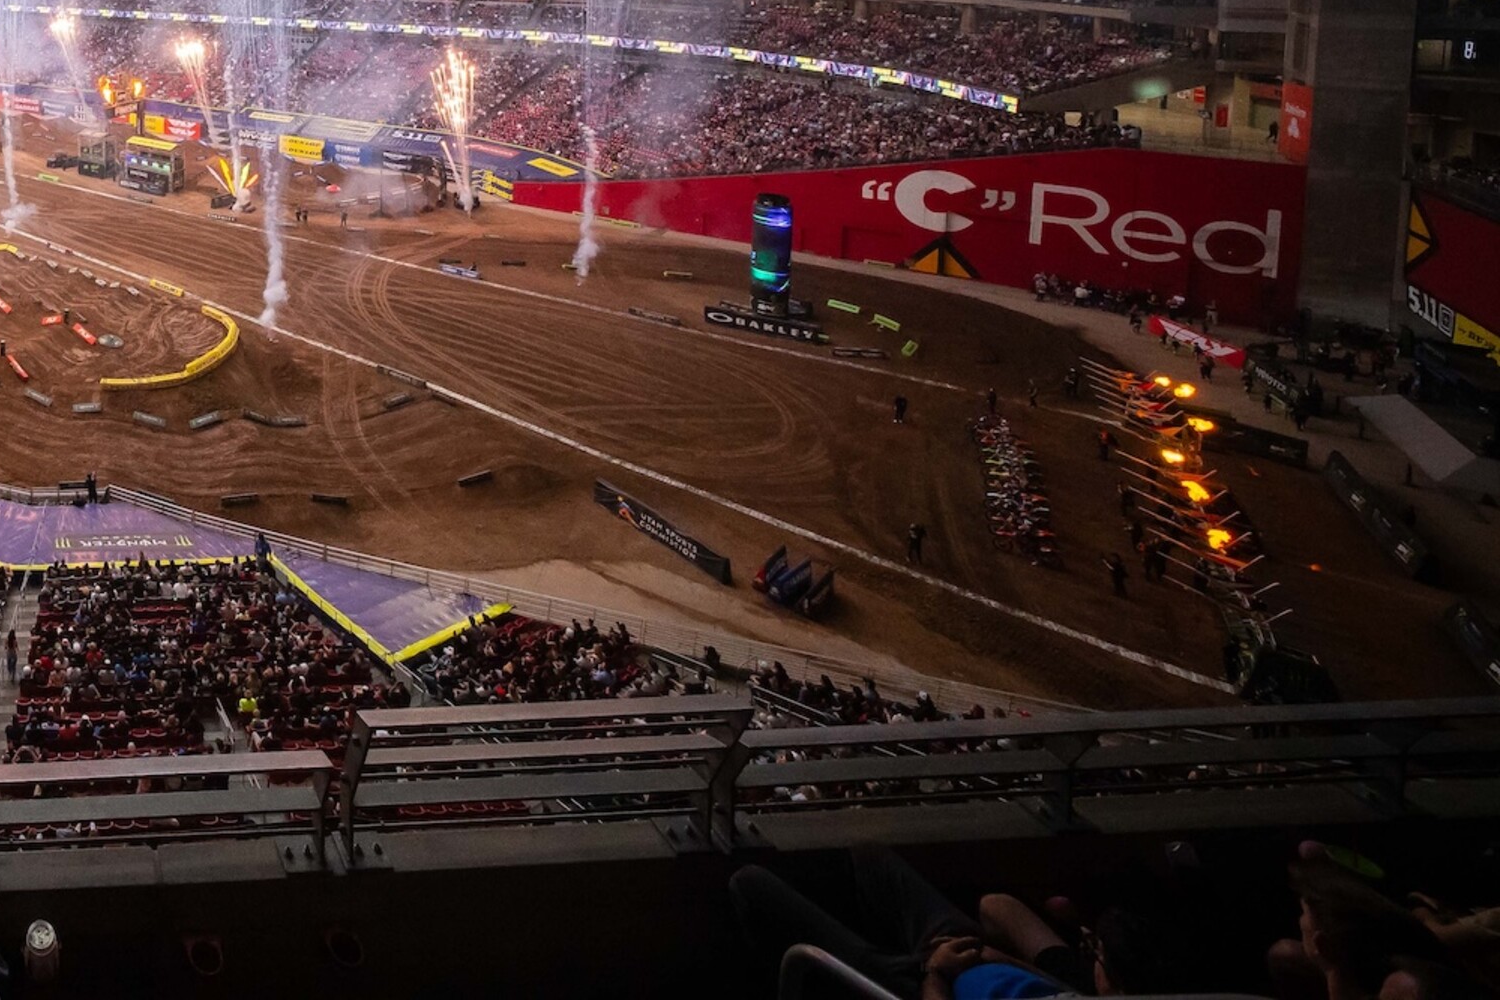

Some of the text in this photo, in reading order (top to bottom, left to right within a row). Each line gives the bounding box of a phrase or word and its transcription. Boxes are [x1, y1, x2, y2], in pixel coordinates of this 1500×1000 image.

[1028, 181, 1282, 279] Red
[1408, 285, 1438, 328] 5.11
[735, 317, 814, 340] OAKLEY
[79, 538, 168, 547] MONSTER
[640, 512, 698, 554] UTAH SPORTS
